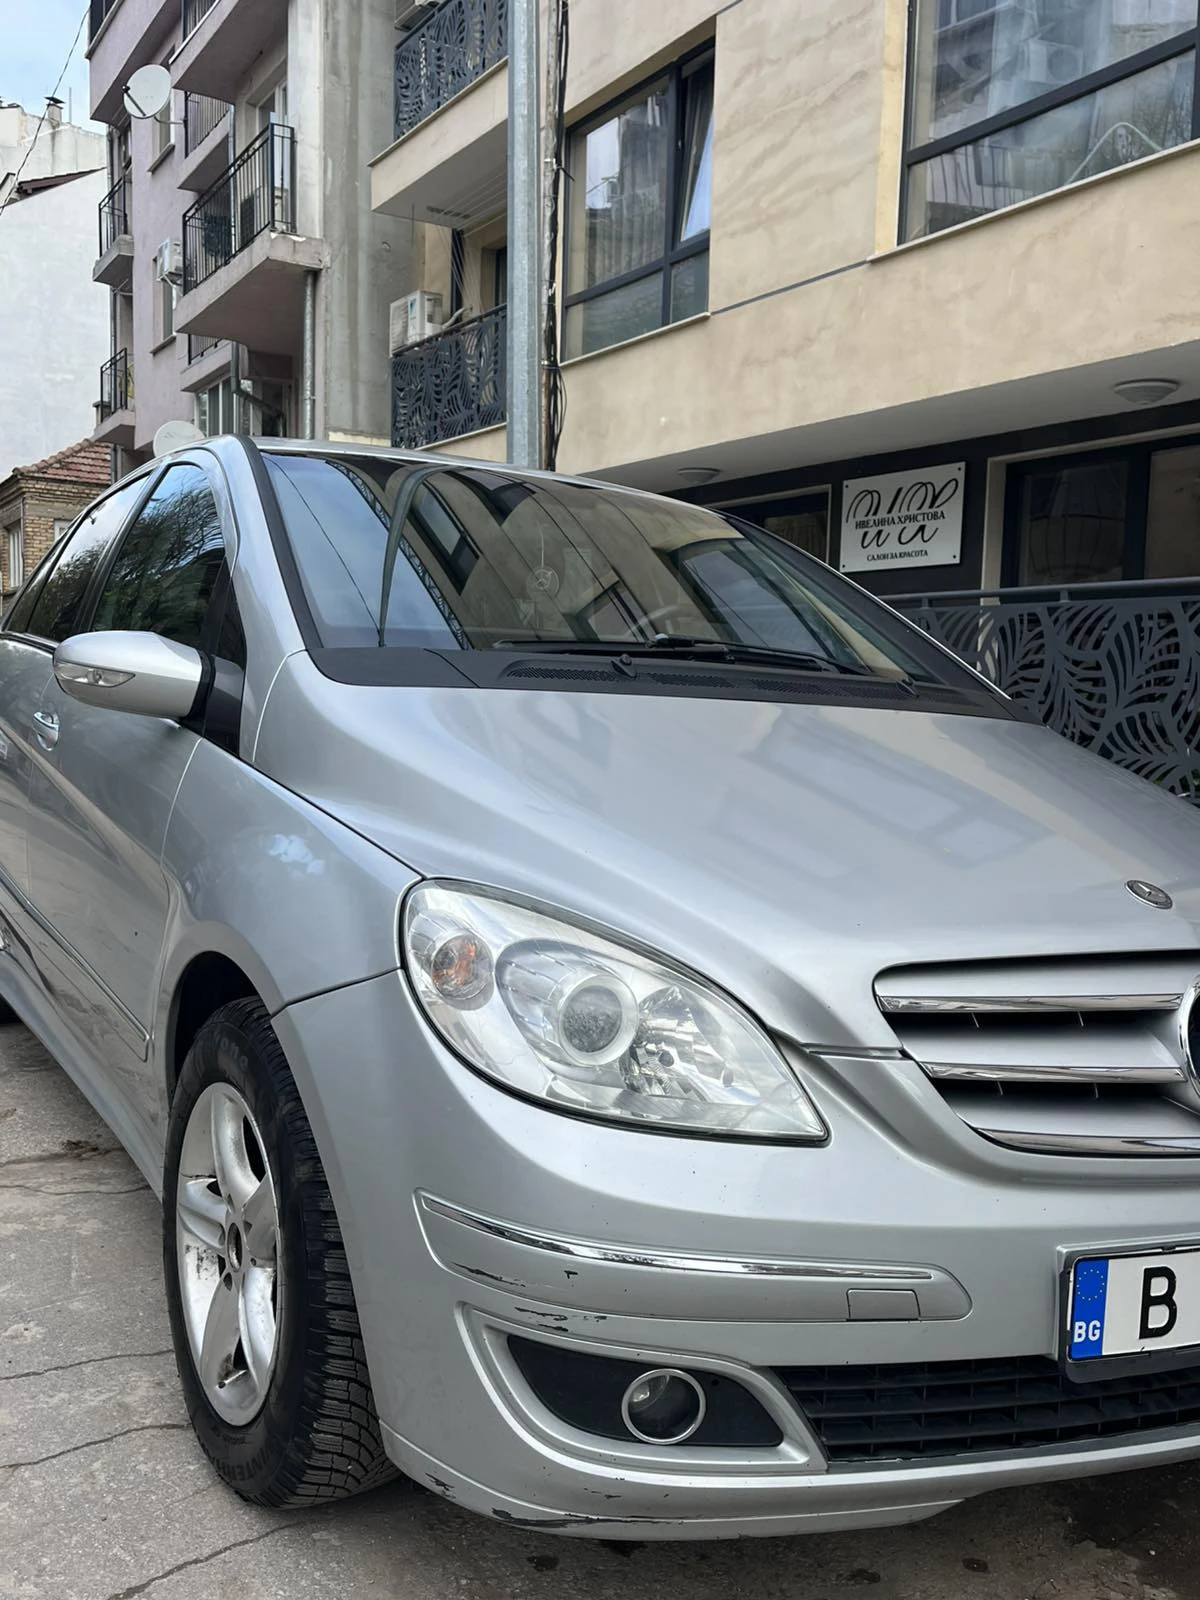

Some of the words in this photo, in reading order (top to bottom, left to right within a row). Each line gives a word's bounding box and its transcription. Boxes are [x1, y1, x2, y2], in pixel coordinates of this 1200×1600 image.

[855, 516, 896, 530] ИВЕЛИНА
[897, 510, 946, 525] ХРИСТОВА
[899, 549, 929, 559] КРАСОТА
[1138, 1265, 1178, 1340] B
[1073, 1320, 1101, 1343] BG
